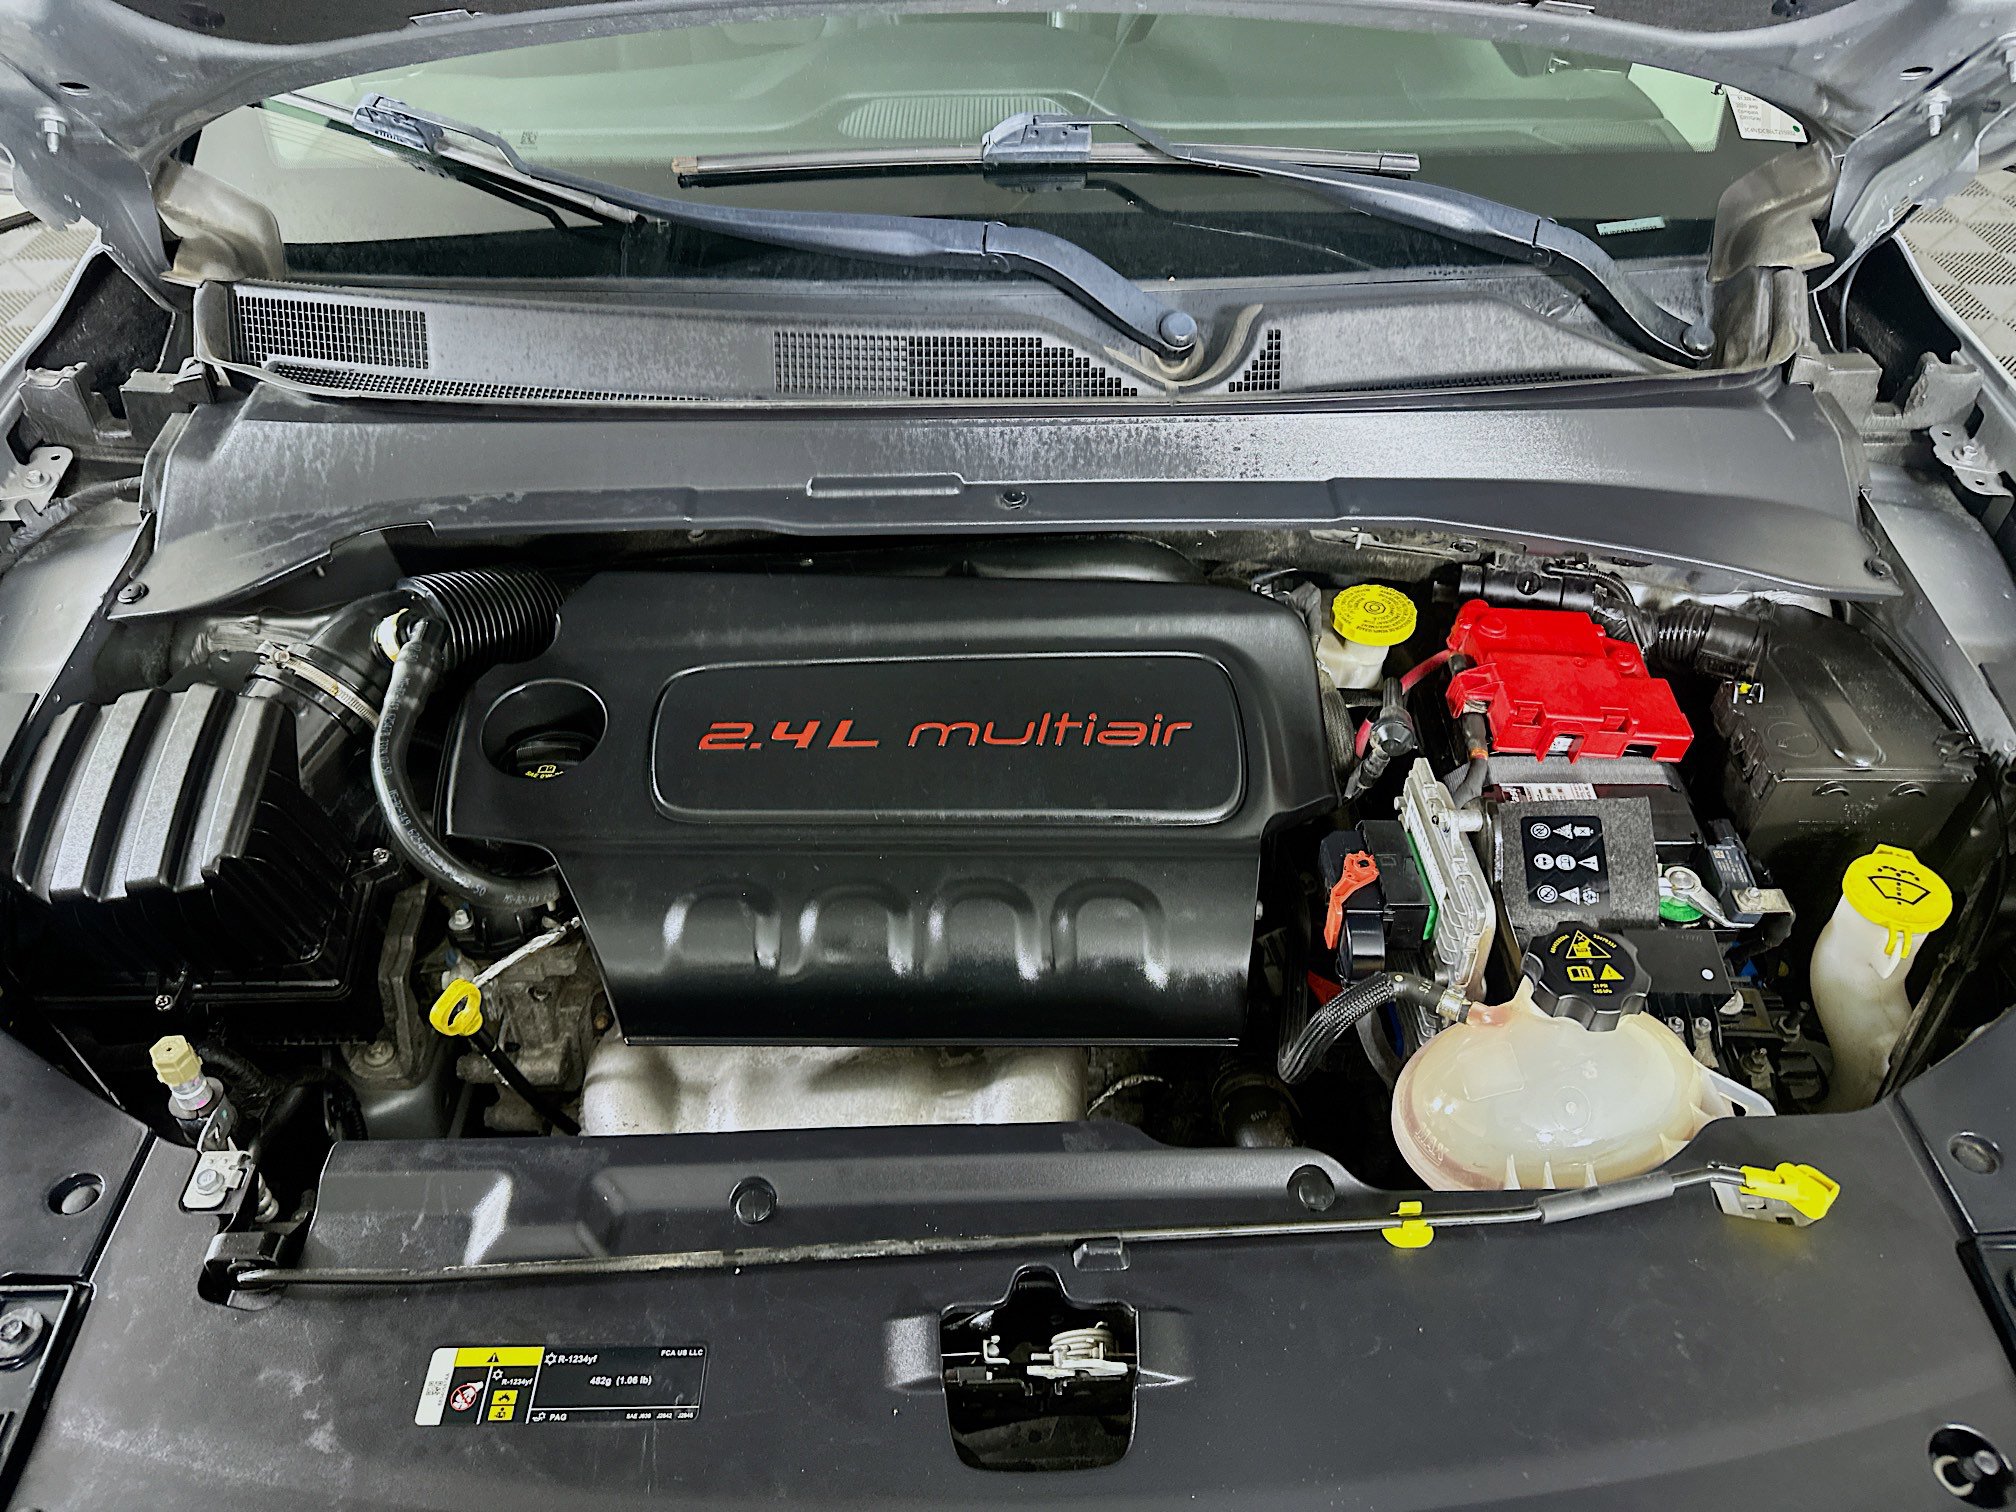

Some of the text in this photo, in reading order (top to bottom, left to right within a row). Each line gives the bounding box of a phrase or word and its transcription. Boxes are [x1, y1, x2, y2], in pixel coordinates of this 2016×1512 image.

[907, 712, 1194, 747] multiair
[660, 1349, 676, 1357] FCA
[557, 1354, 598, 1365] R-1234yf
[501, 1377, 533, 1387] R-1234yf
[589, 1375, 653, 1387] 482g (1.06 lb)
[548, 1413, 568, 1421] PAG
[625, 1412, 638, 1420] SAE
